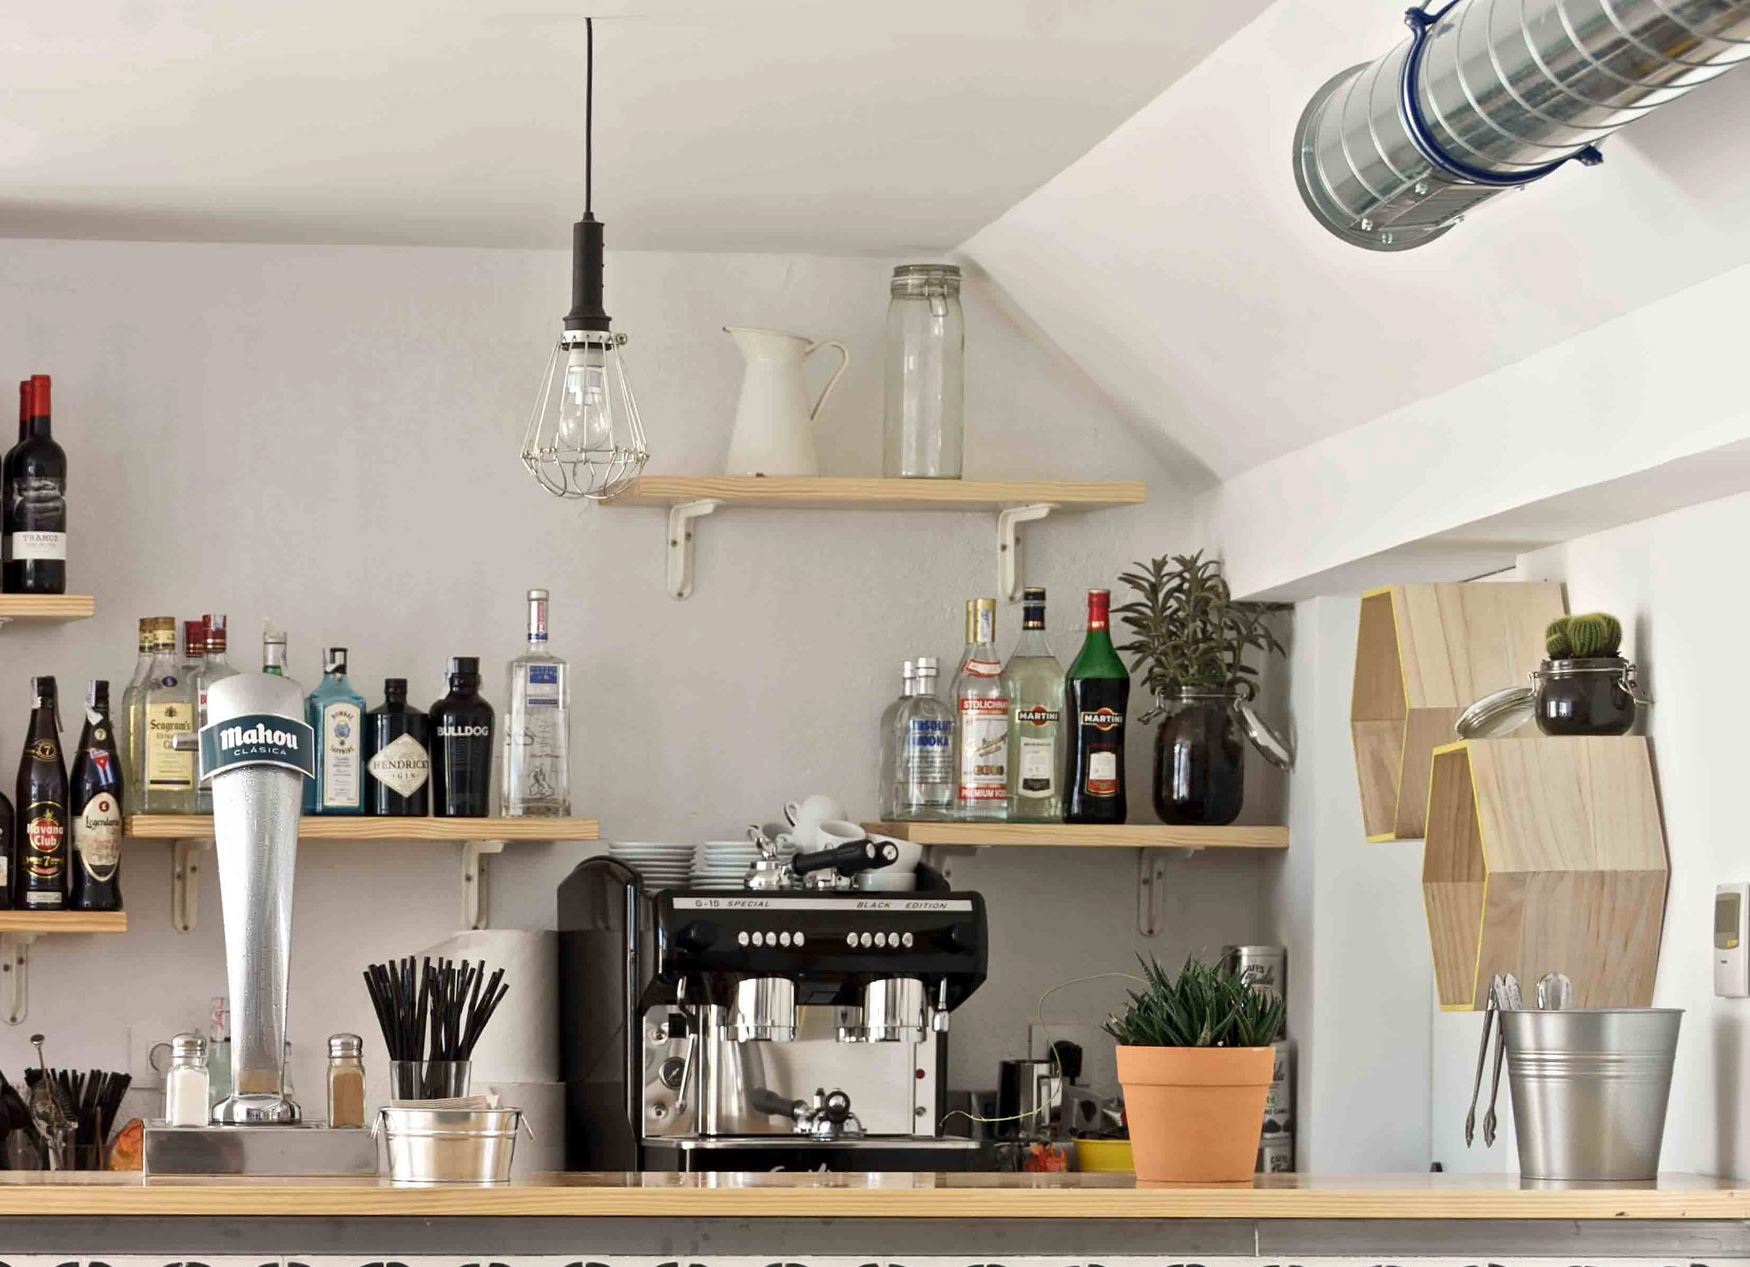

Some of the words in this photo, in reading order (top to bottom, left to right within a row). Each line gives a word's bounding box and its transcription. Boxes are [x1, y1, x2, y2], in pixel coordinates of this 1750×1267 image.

[1019, 712, 1059, 721] MARTINI
[1084, 714, 1123, 724] MARTINI
[150, 719, 191, 733] Seagram's
[437, 726, 489, 737] BULLDOG
[220, 722, 298, 751] Mahou
[961, 789, 994, 799] PREMIUM
[26, 823, 64, 835] Havana
[34, 834, 58, 847] Club
[43, 856, 51, 867] 7
[726, 899, 771, 908] SPECIAL
[856, 900, 892, 909] BLACK
[905, 901, 948, 910] EDITION
